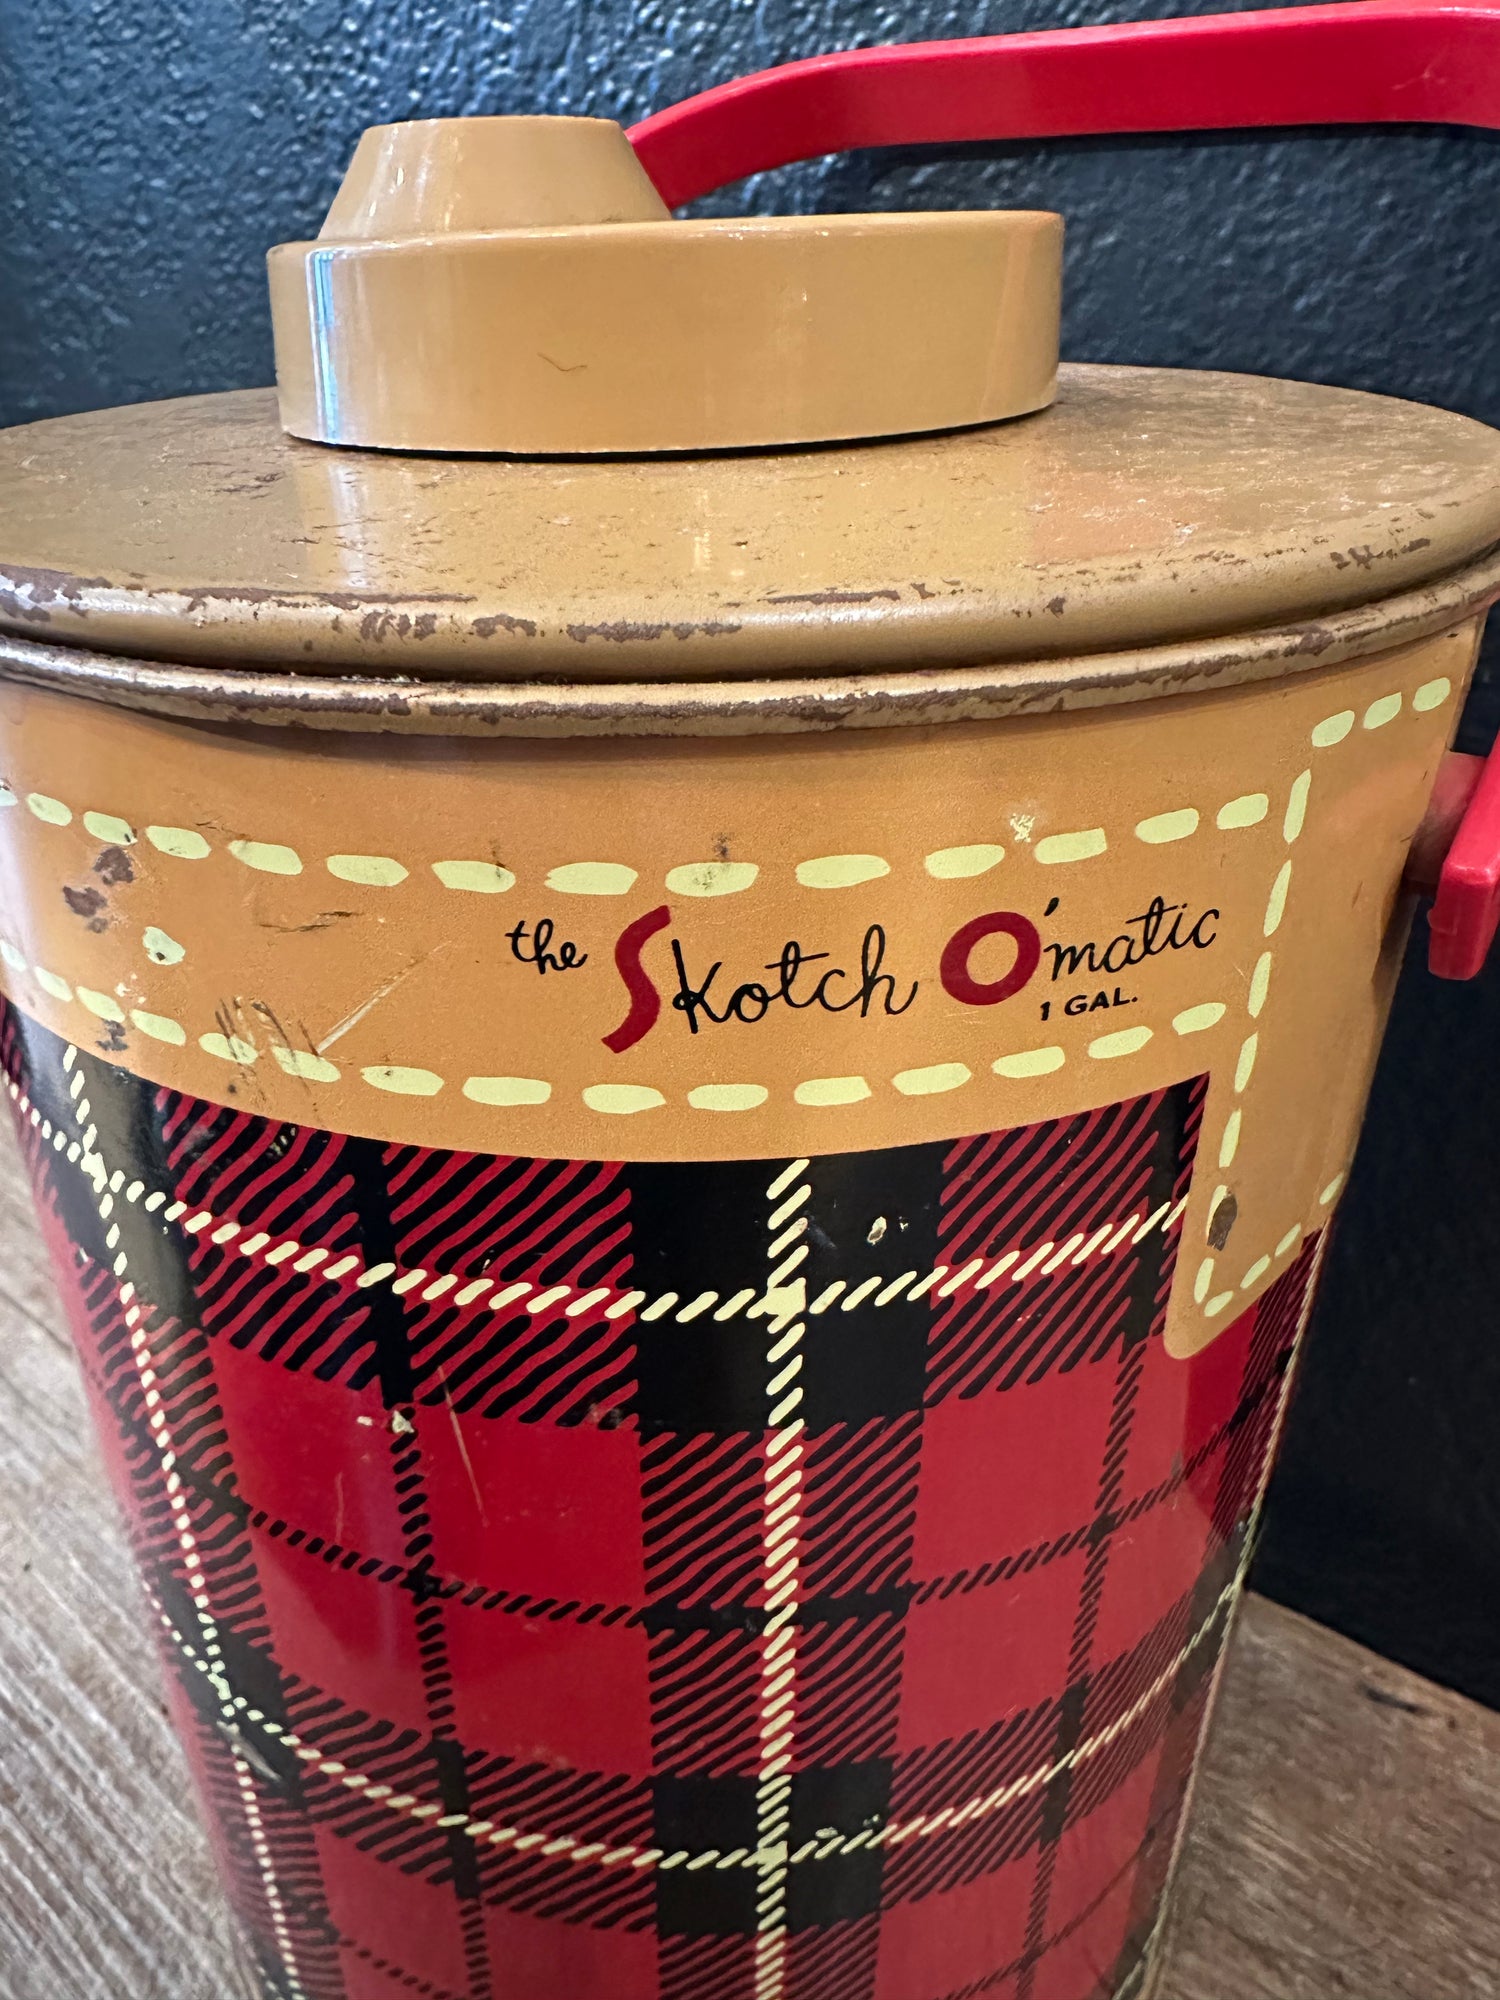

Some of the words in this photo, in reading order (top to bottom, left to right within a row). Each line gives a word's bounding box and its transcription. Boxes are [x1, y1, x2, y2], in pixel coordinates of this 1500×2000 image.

[504, 917, 589, 975] the
[600, 904, 919, 1054] Skotch
[1063, 986, 1139, 1017] GAL.
